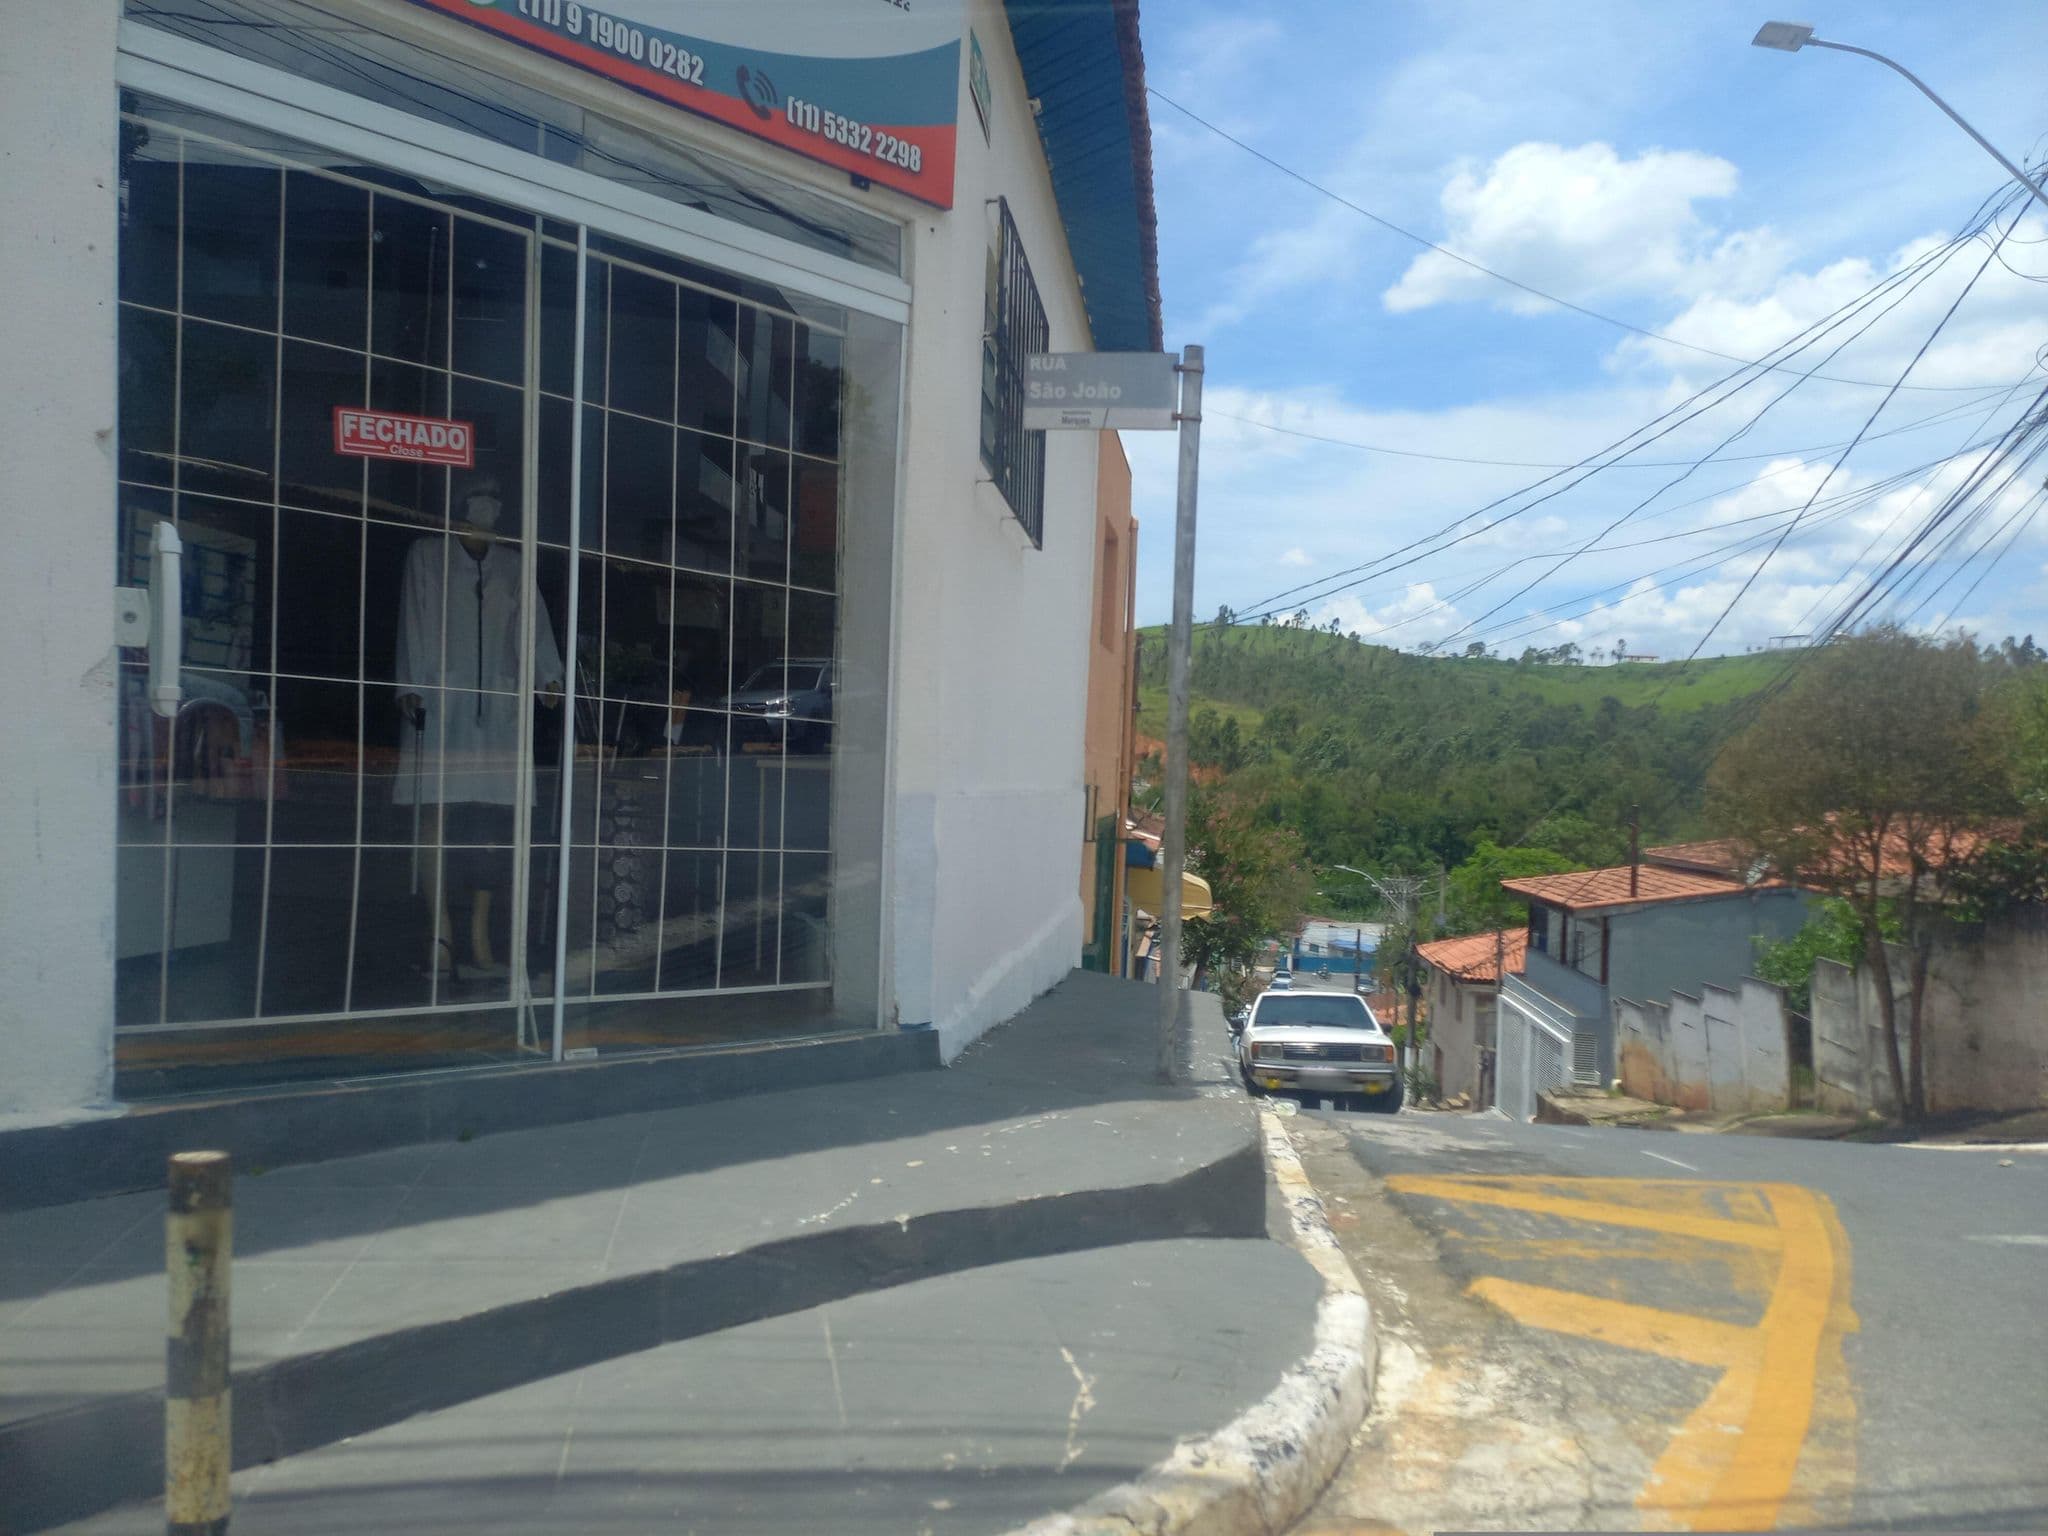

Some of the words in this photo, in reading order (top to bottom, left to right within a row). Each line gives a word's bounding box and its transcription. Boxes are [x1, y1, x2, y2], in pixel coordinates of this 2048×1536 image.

[566, 3, 582, 35] 9
[587, 12, 644, 61] 1900
[649, 37, 705, 86] 0282
[787, 95, 820, 133] (11)
[823, 109, 872, 154] 5332
[875, 131, 922, 172] 2298
[1030, 356, 1067, 371] RUA
[1029, 380, 1067, 399] São
[1072, 380, 1122, 399] João
[343, 414, 465, 450] FECHADO
[389, 444, 424, 457] Close
